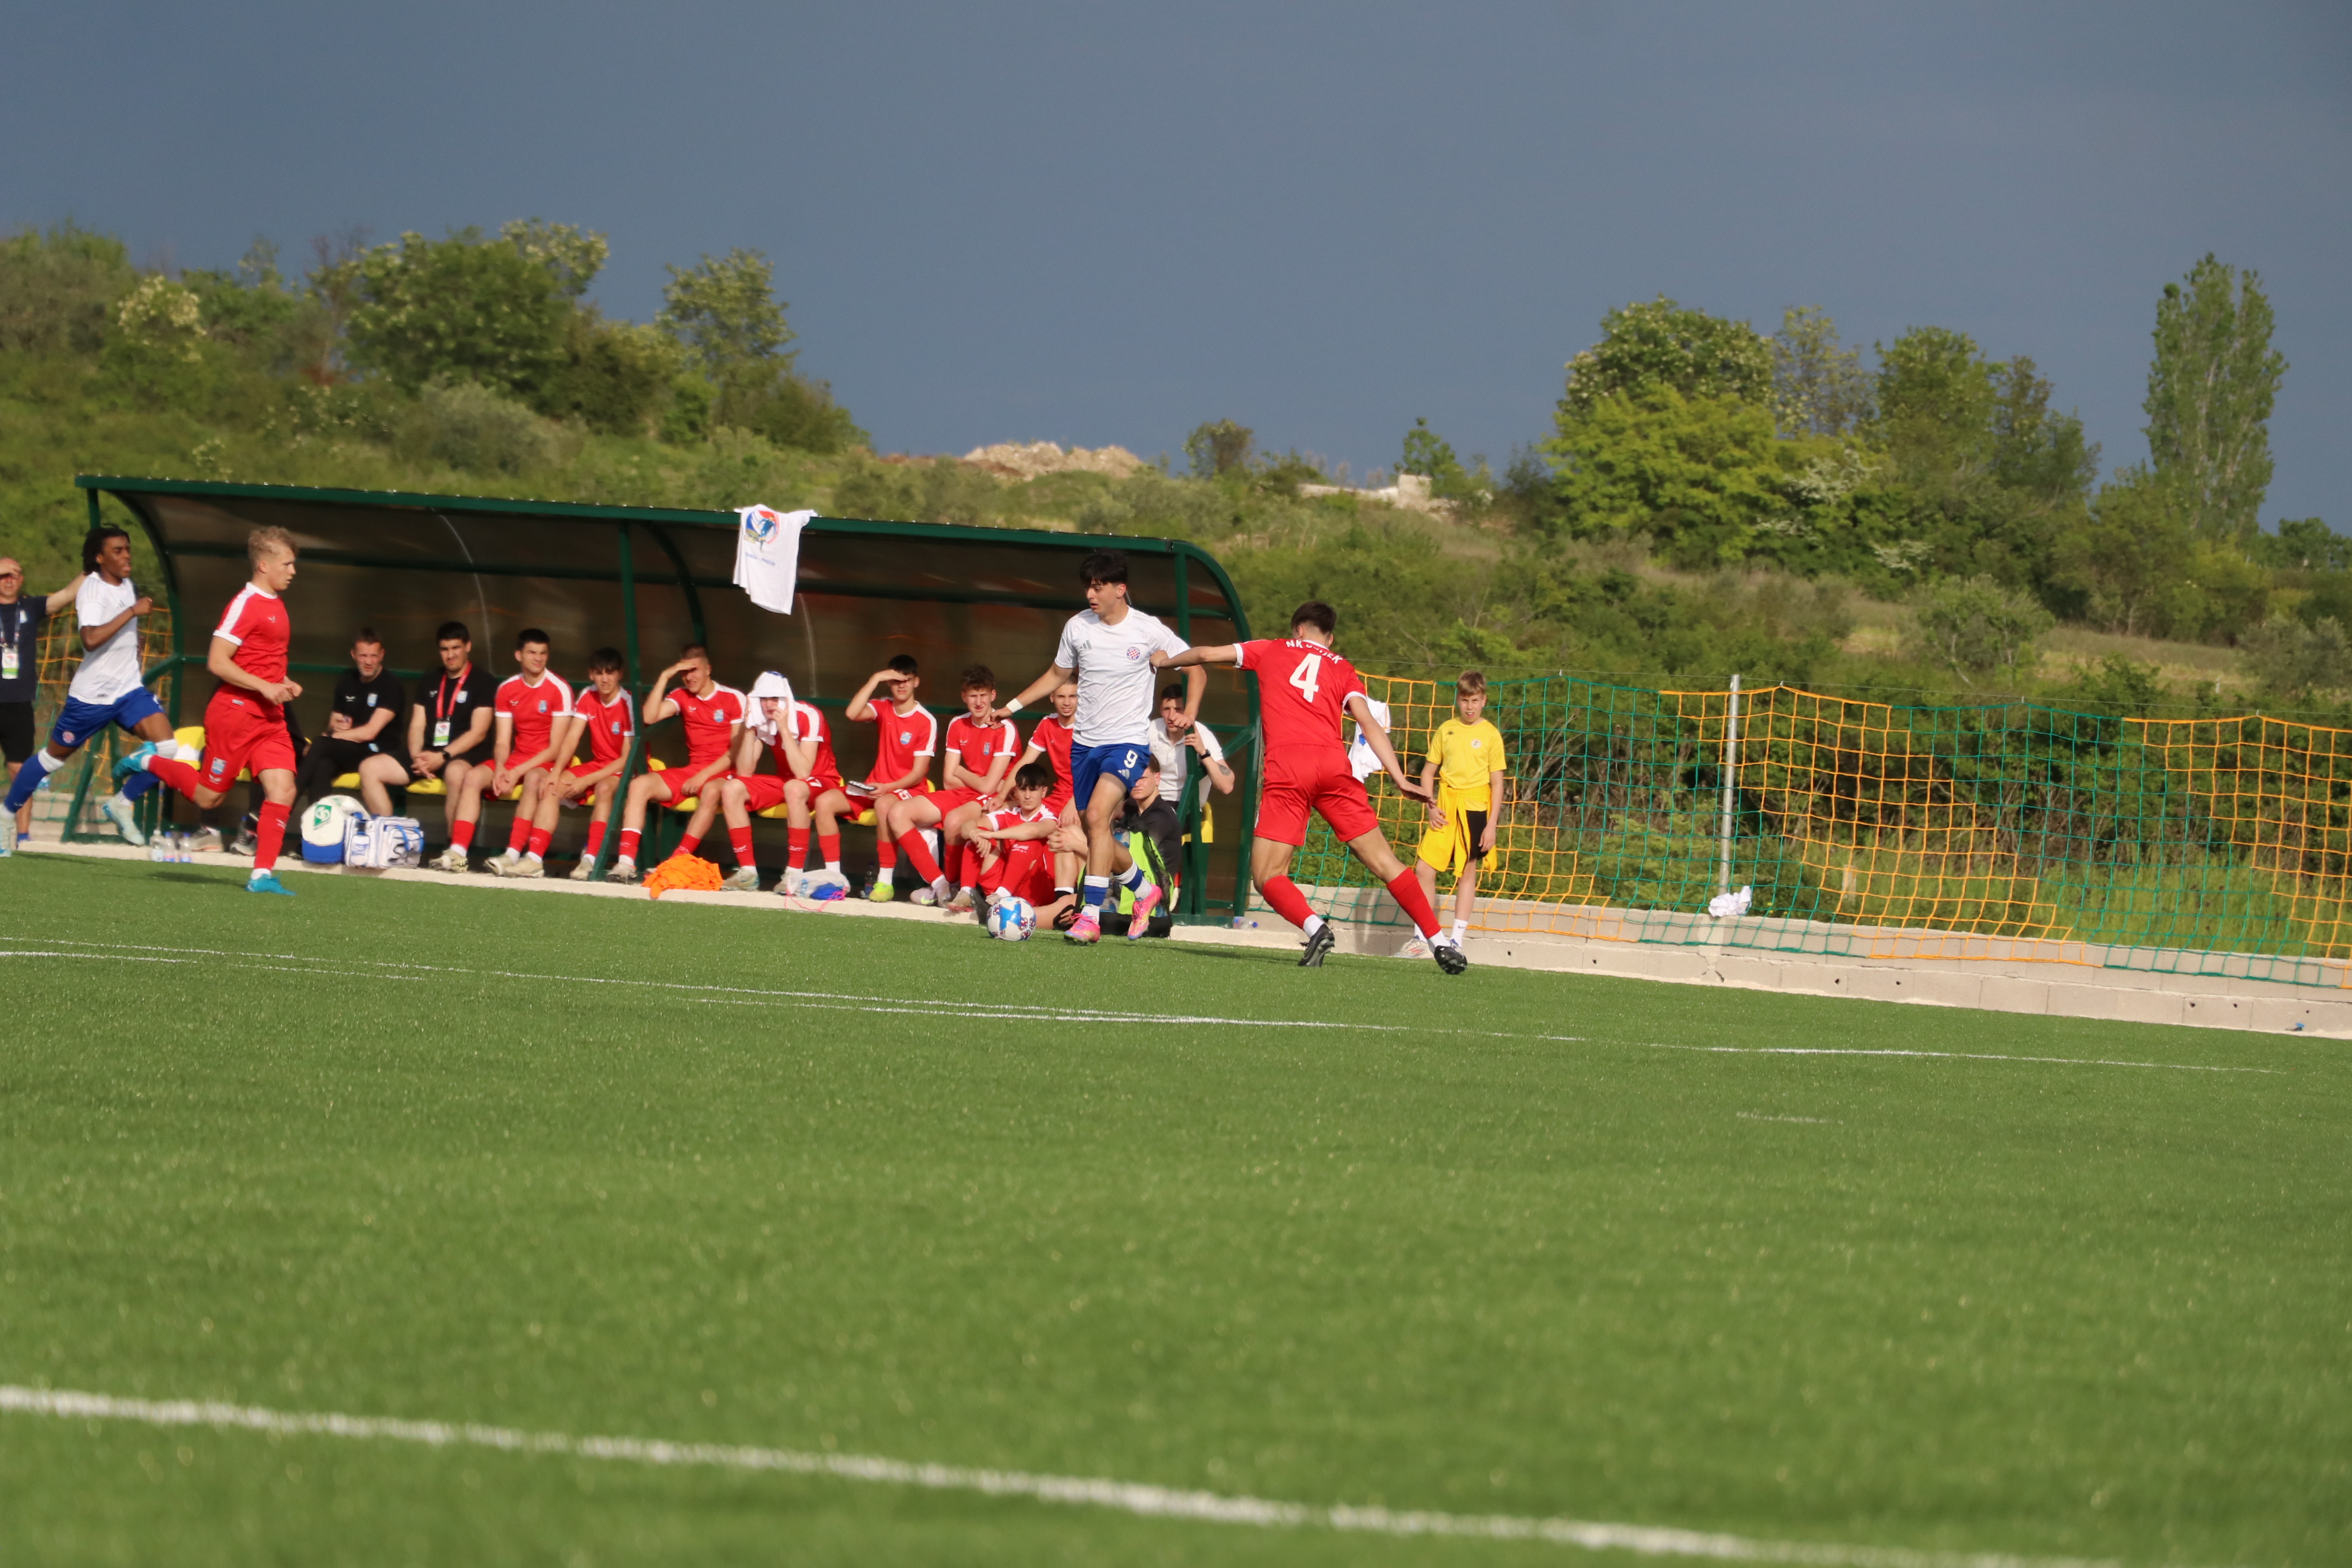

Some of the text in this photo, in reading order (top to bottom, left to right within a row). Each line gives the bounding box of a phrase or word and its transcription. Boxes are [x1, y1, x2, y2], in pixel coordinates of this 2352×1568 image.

[1286, 639, 1343, 665] NK JEK
[1289, 652, 1322, 703] 4
[1123, 749, 1138, 769] 9
